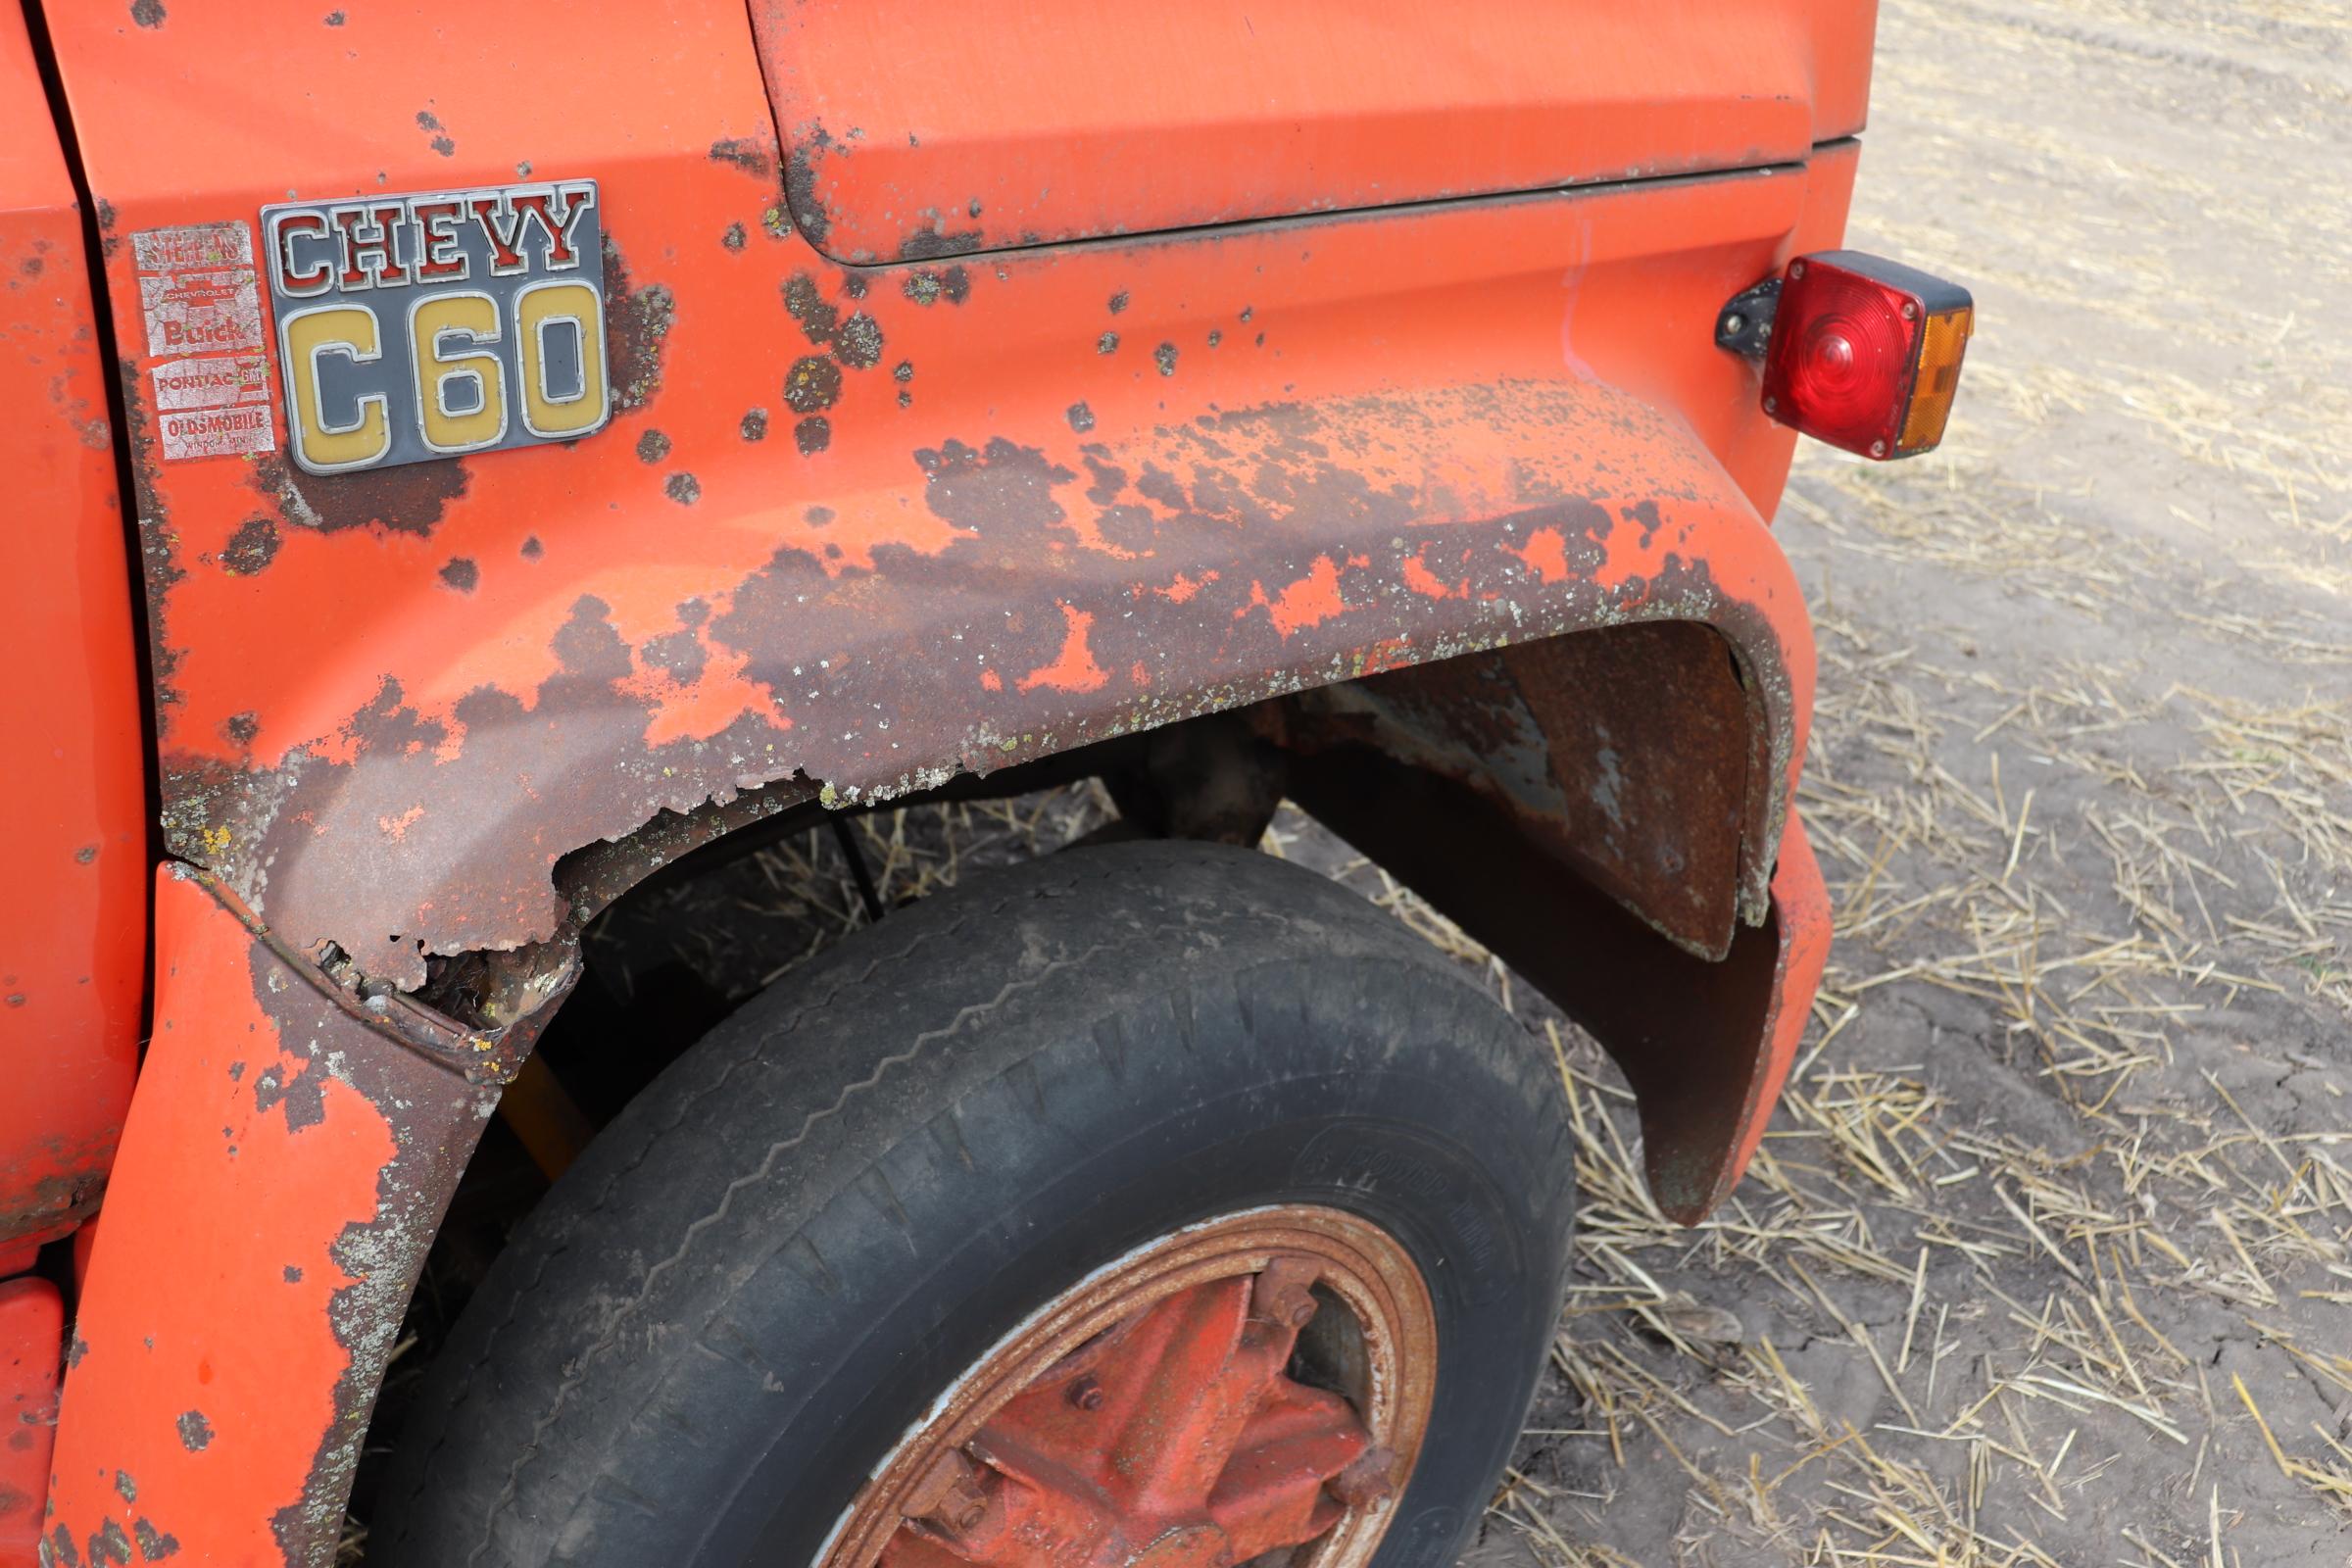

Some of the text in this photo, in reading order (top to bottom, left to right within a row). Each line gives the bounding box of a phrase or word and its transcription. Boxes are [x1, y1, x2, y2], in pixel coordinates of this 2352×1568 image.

[270, 184, 595, 298] CHEVY
[166, 288, 234, 300] CHEVROLET
[164, 317, 247, 346] Buick
[158, 372, 235, 392] PONTIAC
[280, 278, 611, 474] C60
